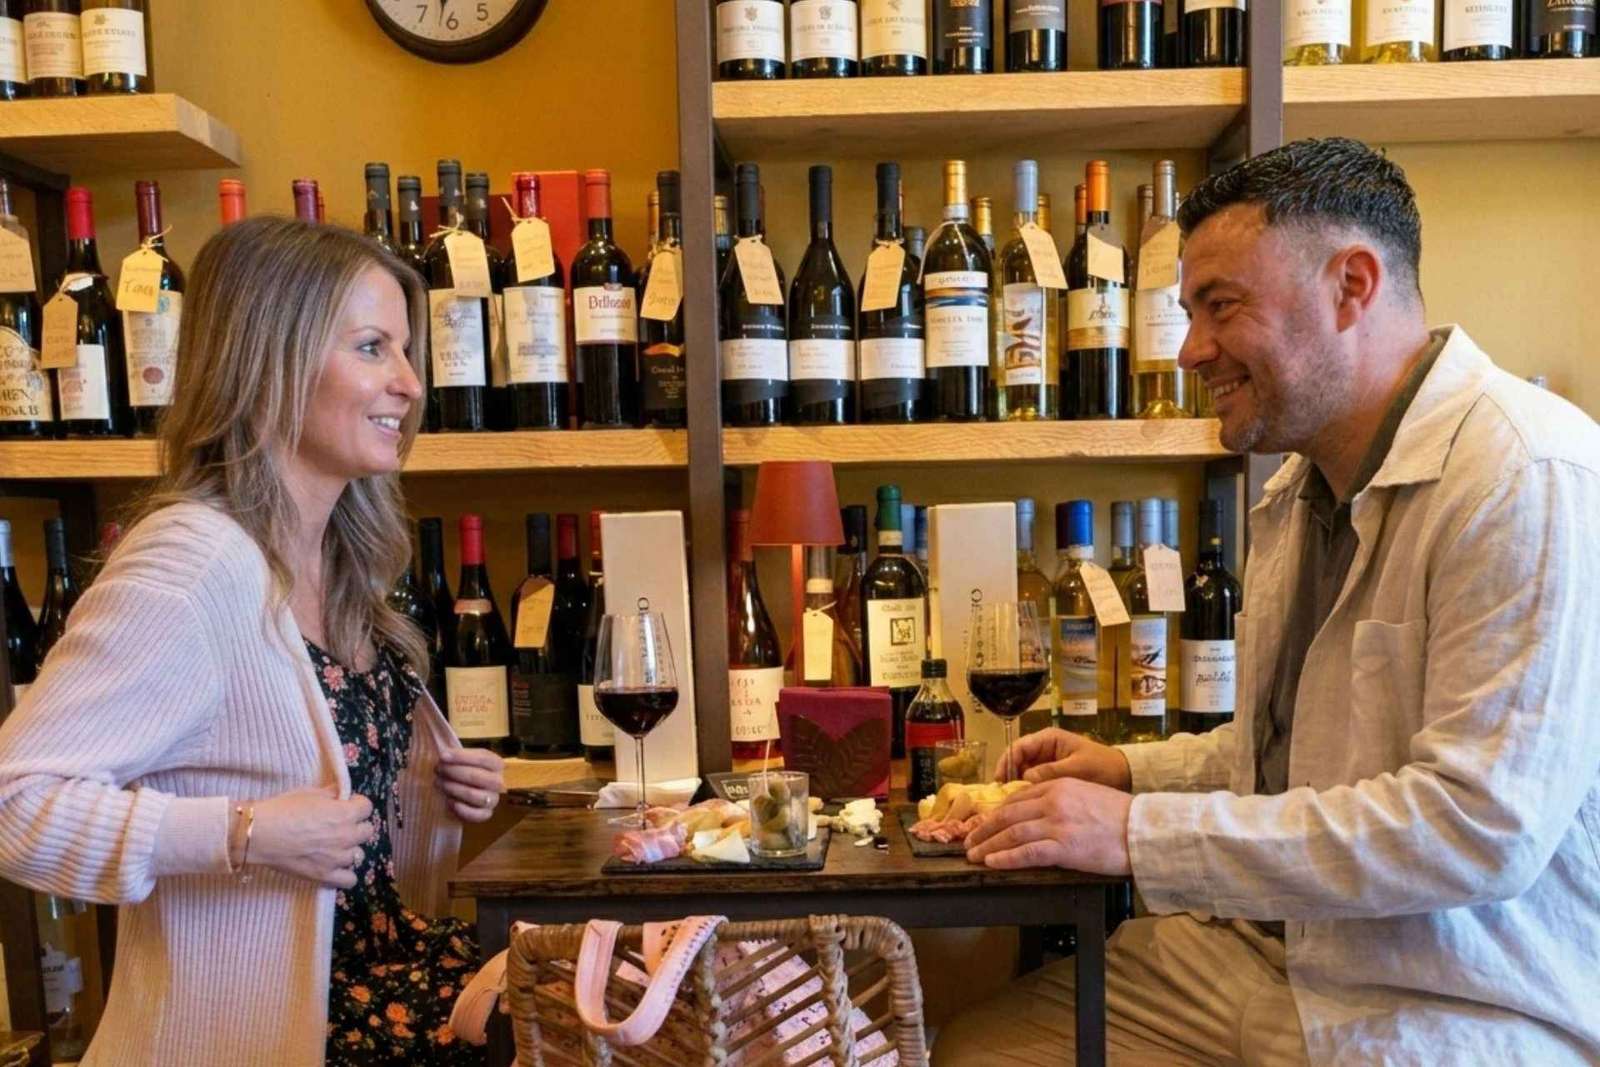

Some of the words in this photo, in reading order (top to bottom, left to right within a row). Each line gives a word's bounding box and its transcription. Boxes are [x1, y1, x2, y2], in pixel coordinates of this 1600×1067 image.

[416, 5, 428, 23] 7
[446, 11, 459, 31] 6
[477, 3, 489, 22] 5
